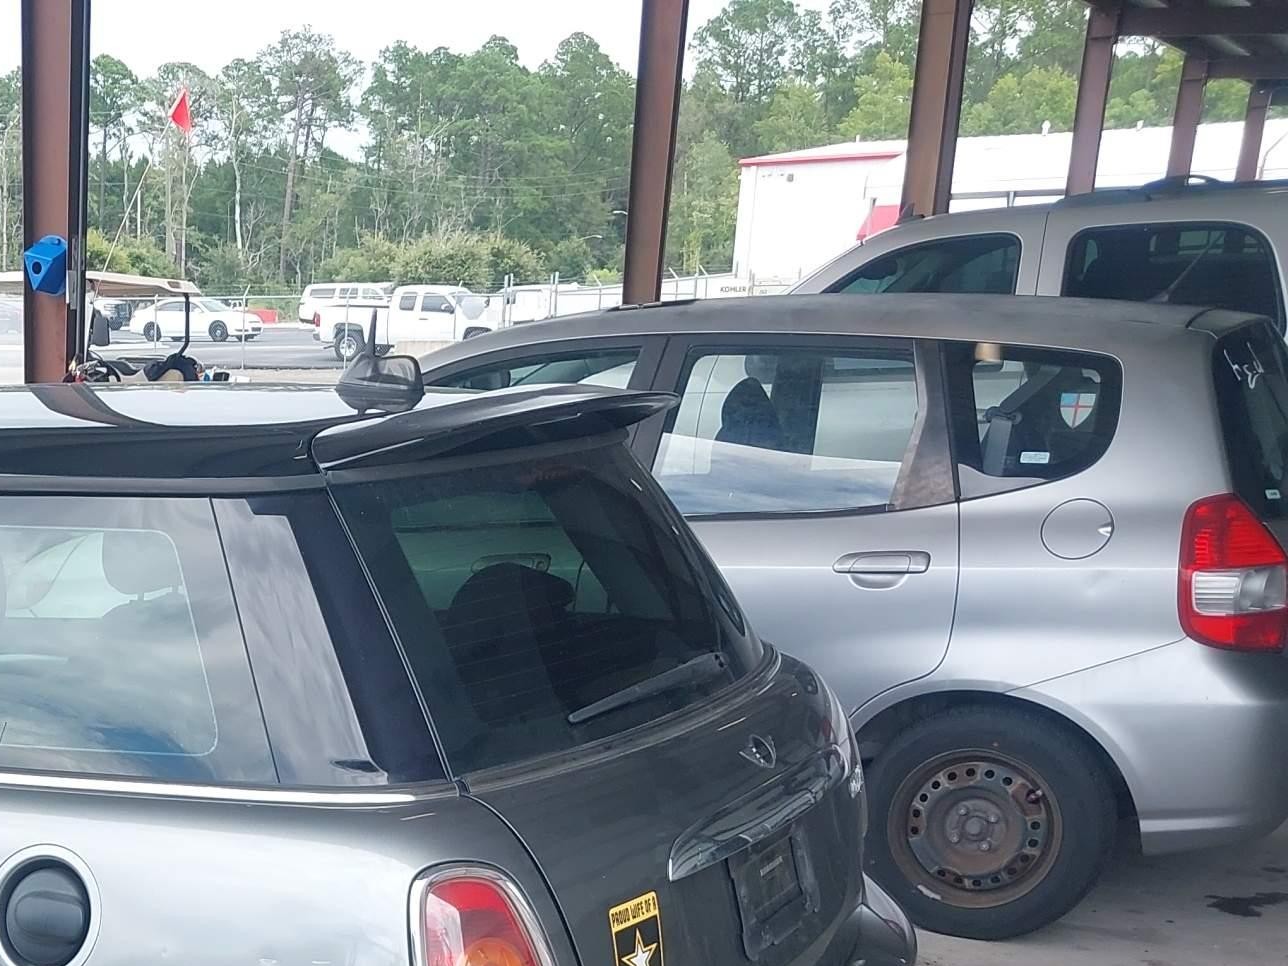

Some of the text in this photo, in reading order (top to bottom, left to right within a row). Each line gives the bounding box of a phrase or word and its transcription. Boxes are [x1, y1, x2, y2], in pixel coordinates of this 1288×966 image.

[611, 895, 657, 928] PROUD WIFE OF A
